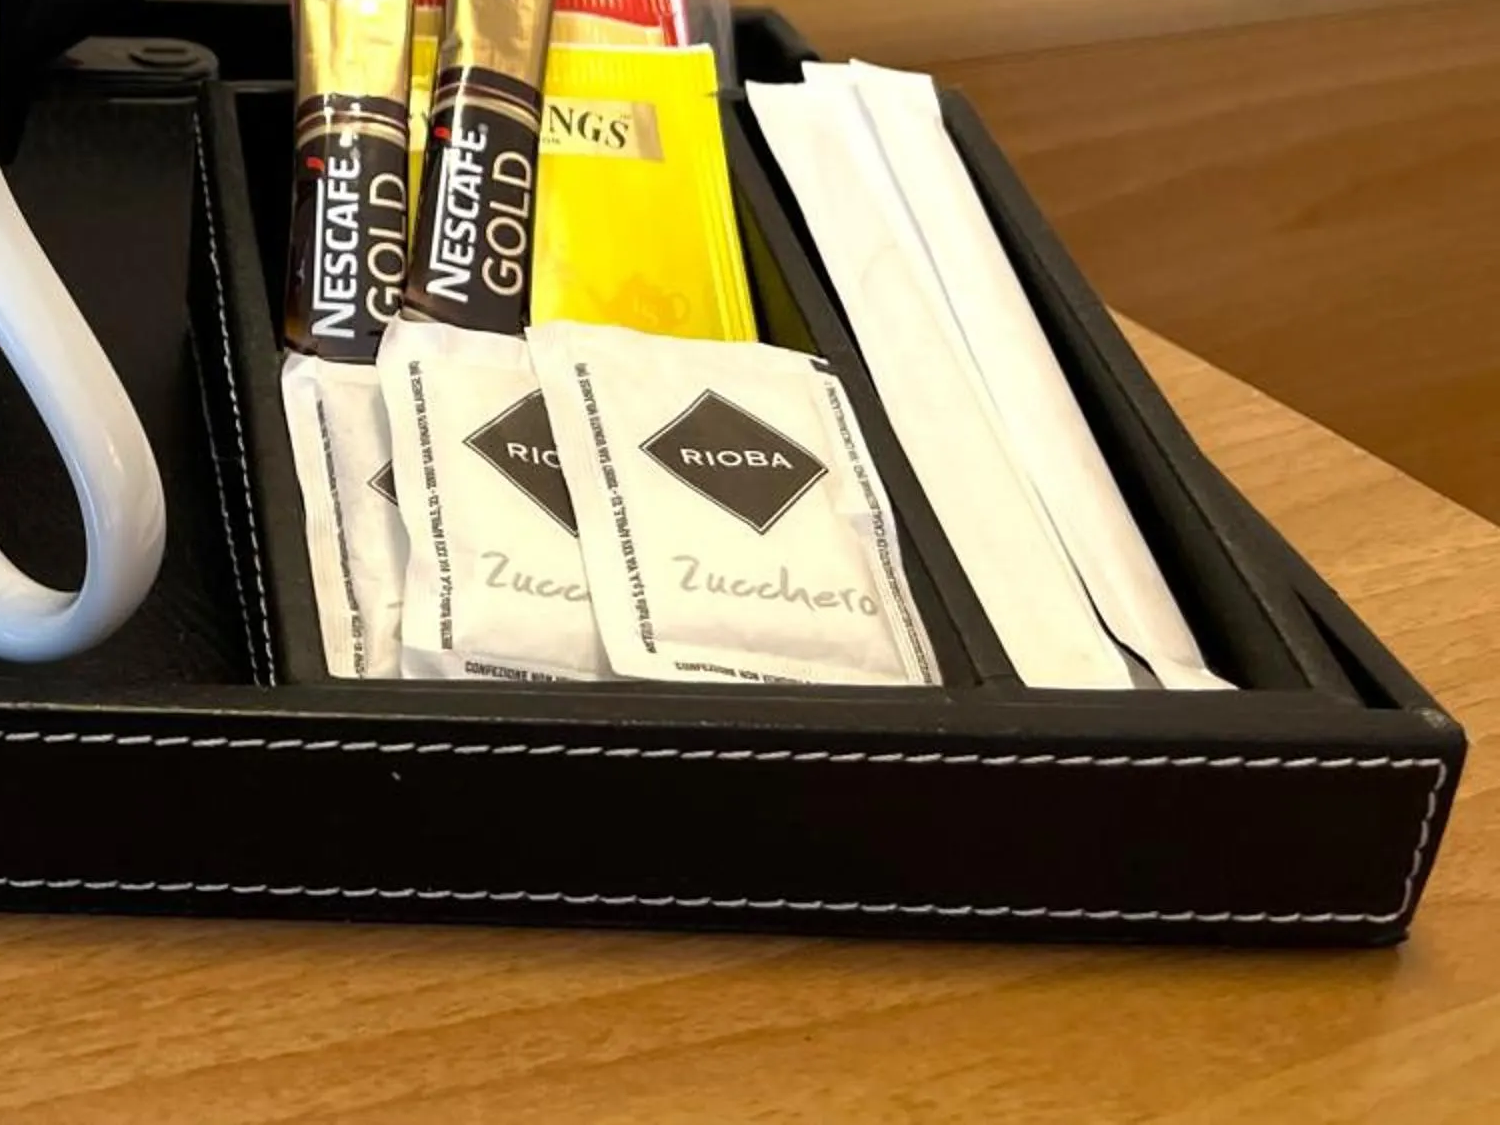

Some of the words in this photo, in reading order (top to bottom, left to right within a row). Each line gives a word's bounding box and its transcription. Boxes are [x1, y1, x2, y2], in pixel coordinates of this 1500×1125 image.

[549, 104, 629, 149] NGS
[366, 173, 406, 324] GOLD
[482, 151, 532, 295] GOLD
[507, 443, 561, 469] RIO
[679, 447, 794, 470] RIOBA
[481, 551, 592, 602] Zucc
[672, 555, 879, 617] Zucchero
